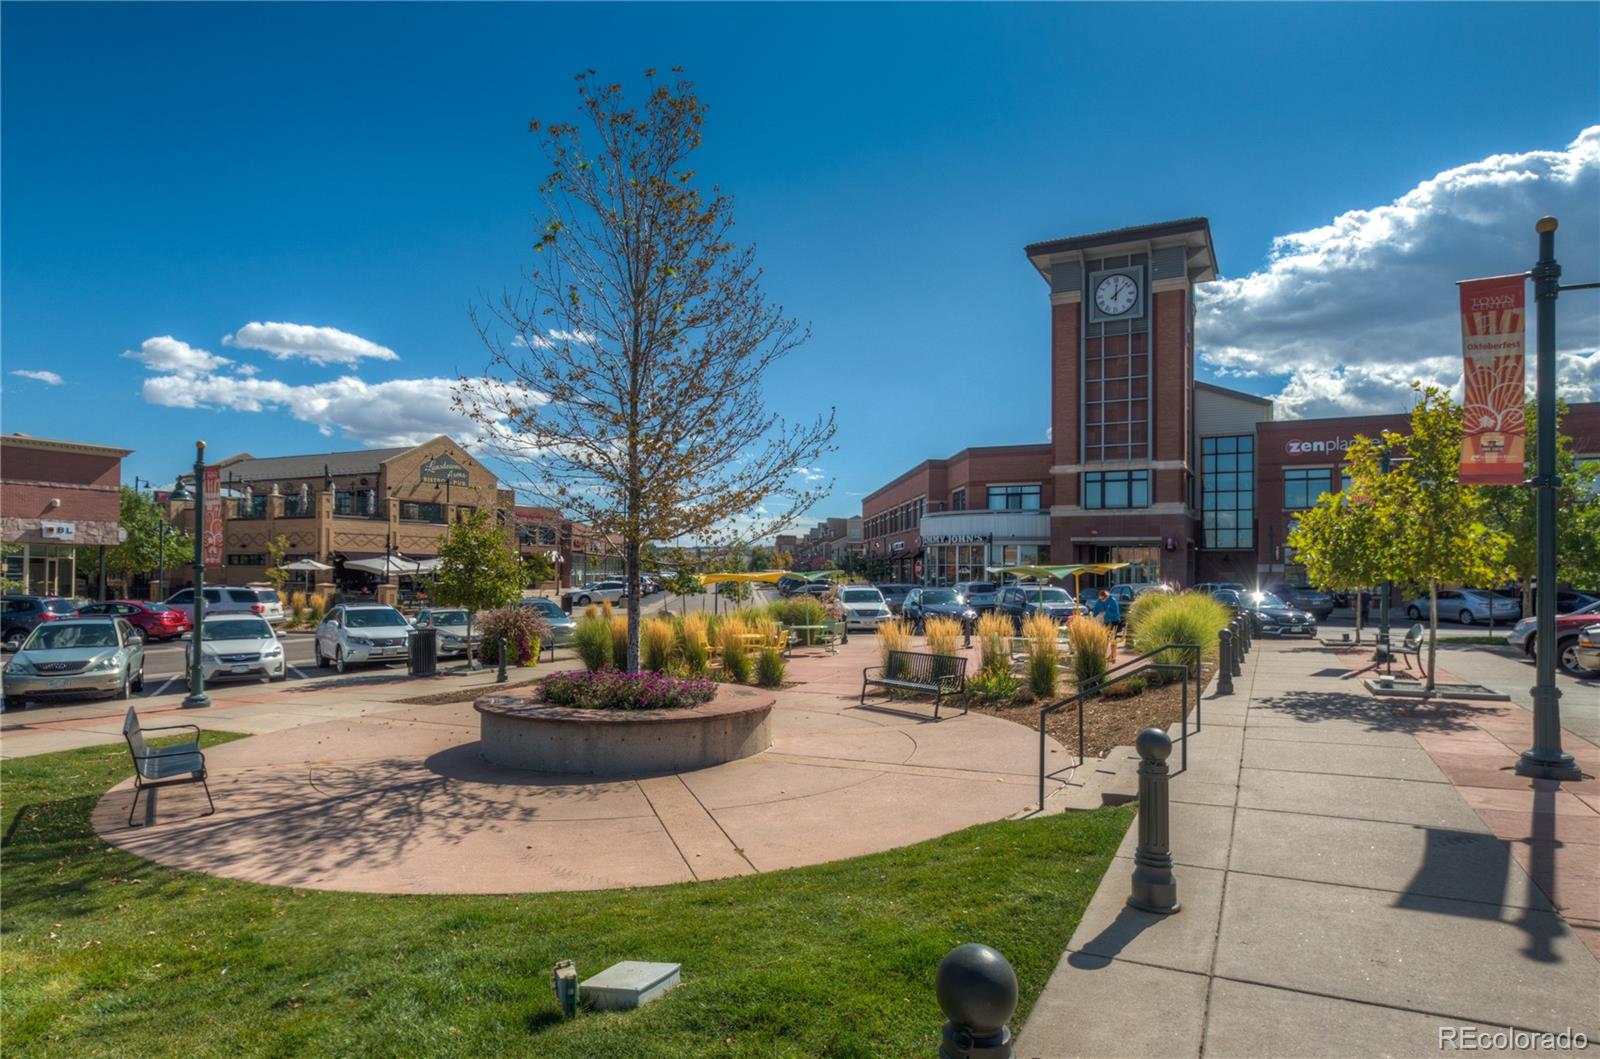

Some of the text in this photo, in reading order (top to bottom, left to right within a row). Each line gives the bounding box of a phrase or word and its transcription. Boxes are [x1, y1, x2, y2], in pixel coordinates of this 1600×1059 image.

[1472, 295, 1514, 304] TOWN
[1467, 341, 1520, 350] Oktoberfest
[923, 535, 982, 545] MMY JOHN'S
